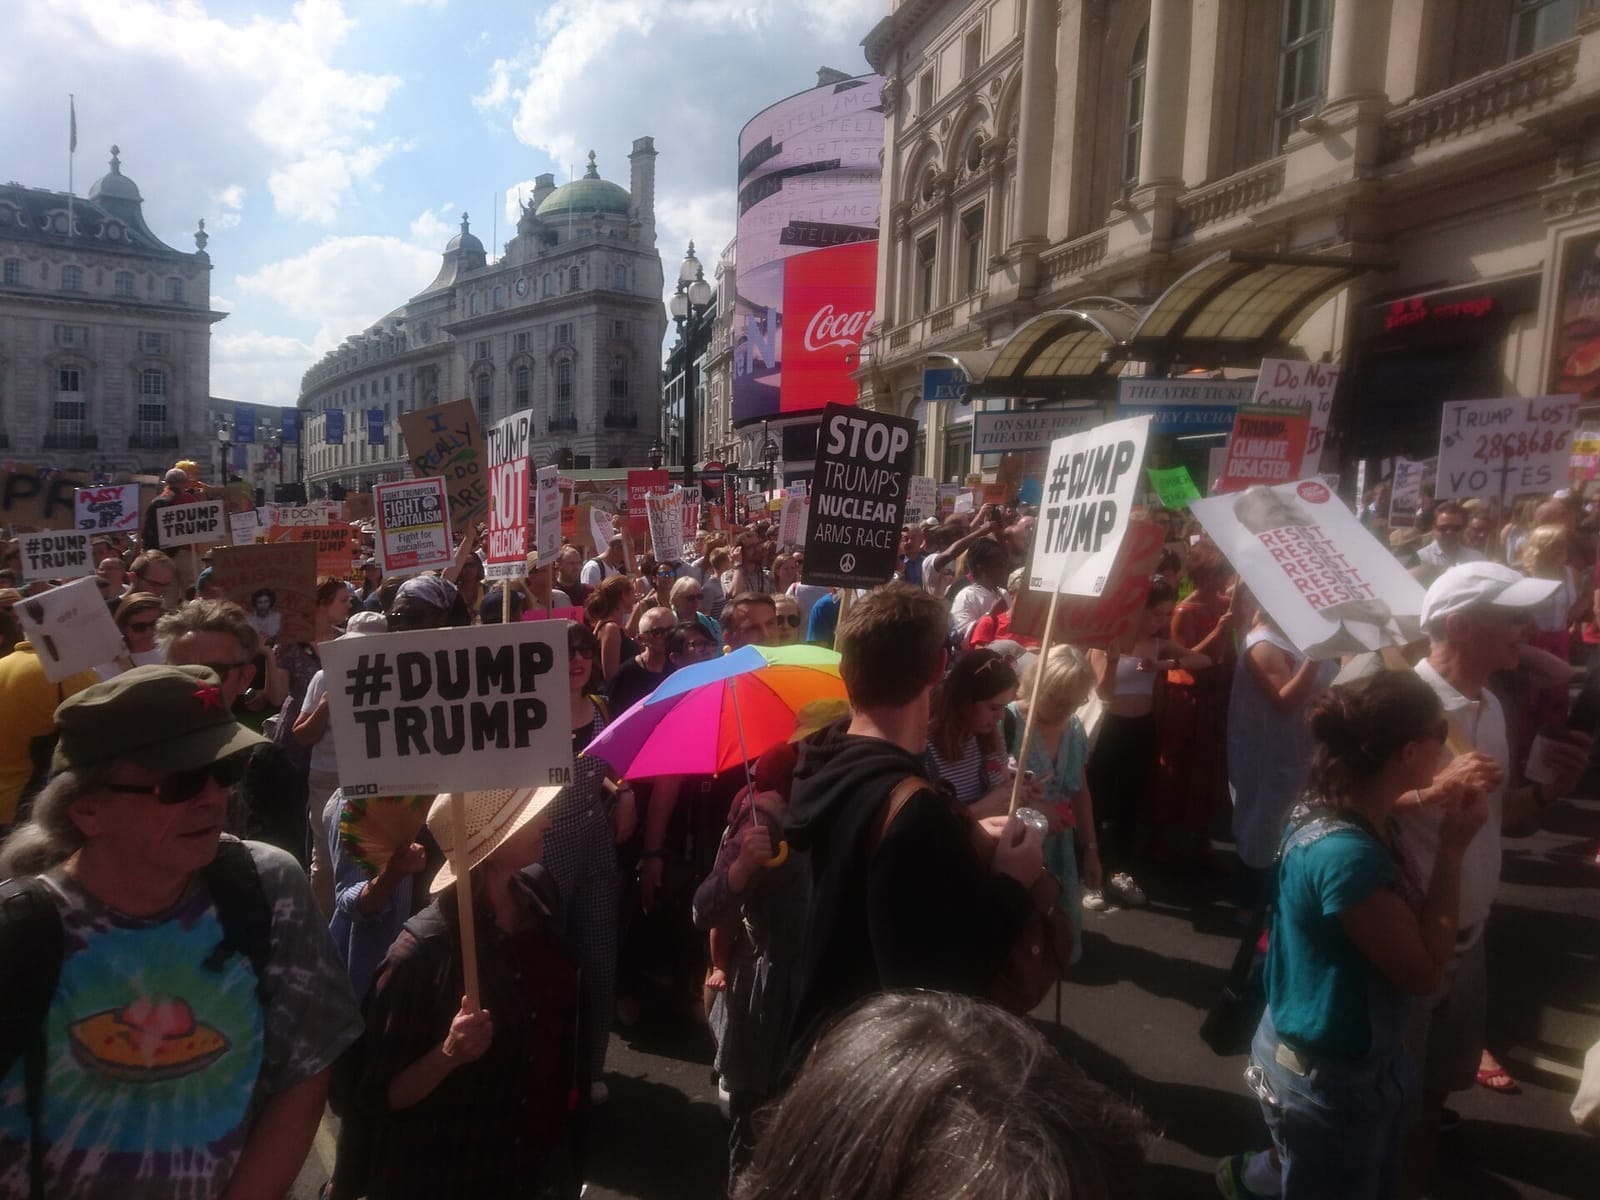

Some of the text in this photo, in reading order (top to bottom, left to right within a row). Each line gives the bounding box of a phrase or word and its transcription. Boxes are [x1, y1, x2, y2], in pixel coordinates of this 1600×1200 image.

[1128, 386, 1200, 400] THEATRE
[993, 419, 1017, 432] ON
[1017, 418, 1049, 431] SALE
[1453, 405, 1514, 428] TRUMP
[489, 417, 528, 468] TRUMP
[826, 415, 909, 465] STOP
[981, 431, 1041, 445] THEATRE
[1232, 440, 1289, 459] CLIMATE
[454, 462, 479, 479] DO
[824, 460, 901, 497] TRUMP'S
[1048, 440, 1136, 504] #DUMP
[1227, 459, 1291, 479] DISASTER
[1449, 465, 1552, 496] VOTES
[490, 458, 526, 531] NOT
[162, 505, 219, 524] #DUMP
[383, 498, 421, 517] FIGHT
[384, 510, 442, 529] CAPITALISM
[817, 494, 897, 524] NUCLEAR
[164, 519, 218, 538] TRUMP
[814, 523, 852, 545] ARMS
[855, 528, 893, 549] RACE
[1044, 500, 1117, 554] TRUMP
[1258, 526, 1325, 548] RESIST
[25, 535, 87, 554] #DUMP
[489, 526, 525, 558] WELCOME
[1270, 539, 1337, 563] RESIST
[28, 551, 87, 570] TRUMP
[1281, 553, 1350, 578] RESIST
[1293, 568, 1363, 594] RESIST
[1305, 583, 1376, 610] RESIST
[345, 641, 553, 707] #DUMP
[354, 698, 547, 759] TRUMP
